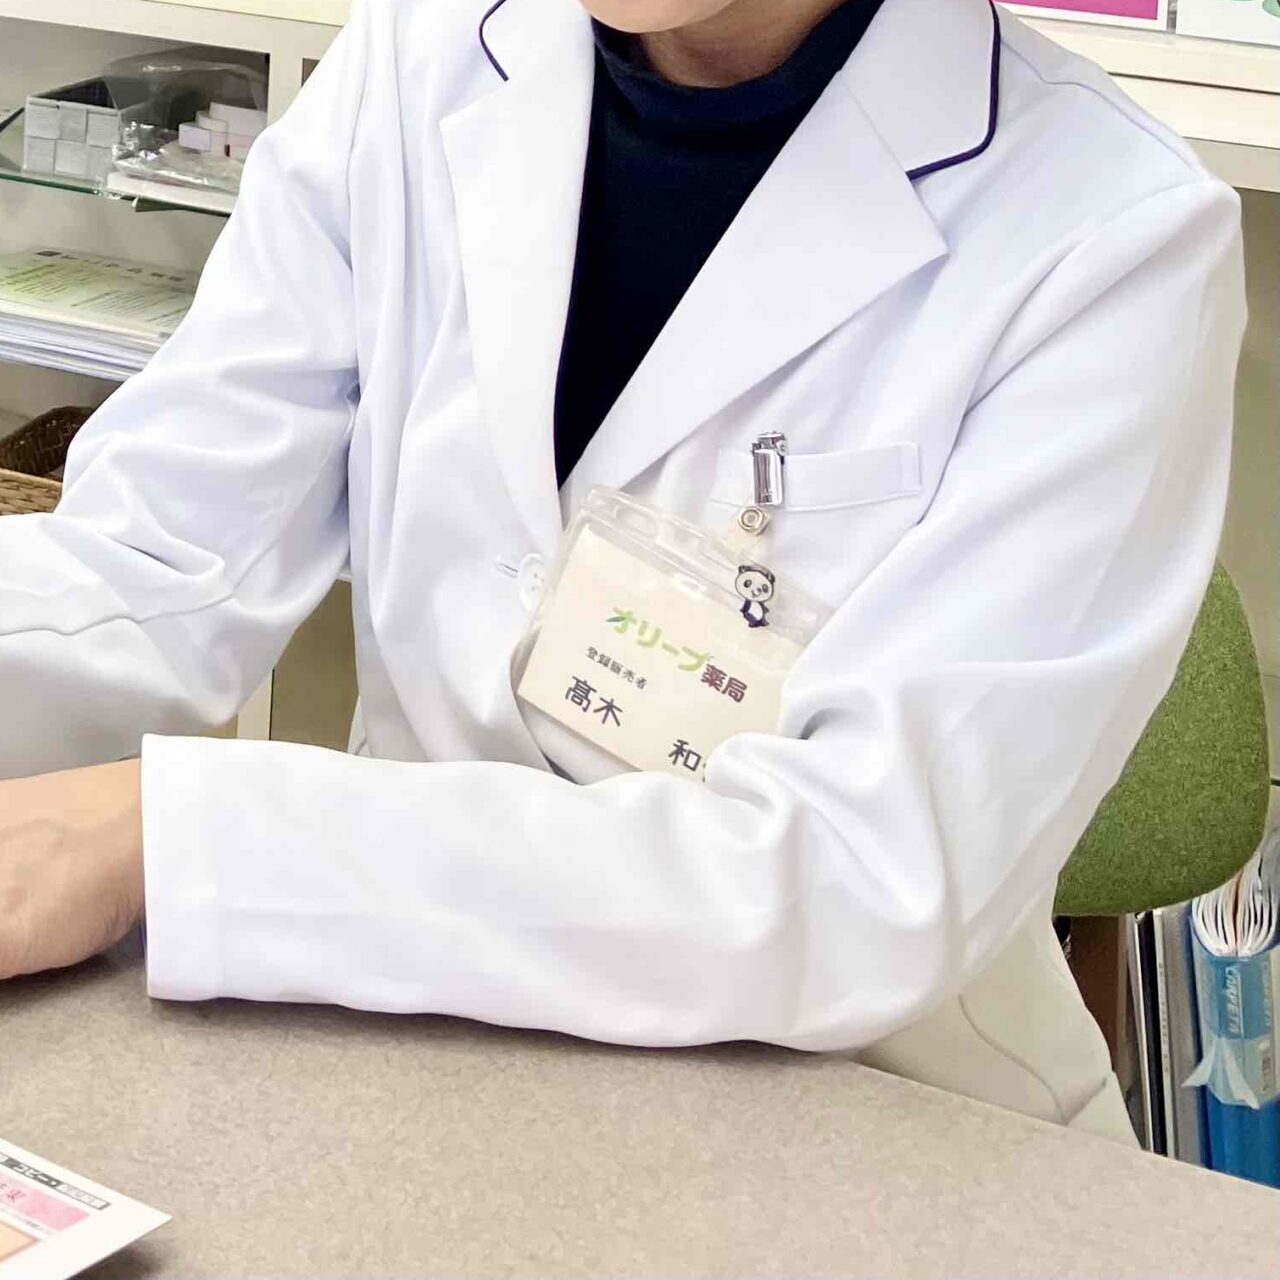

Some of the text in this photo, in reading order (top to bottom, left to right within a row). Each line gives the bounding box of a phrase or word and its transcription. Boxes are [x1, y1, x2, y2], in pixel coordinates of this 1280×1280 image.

[606, 606, 749, 704] オリーブ薬局
[668, 738, 707, 782] 和
